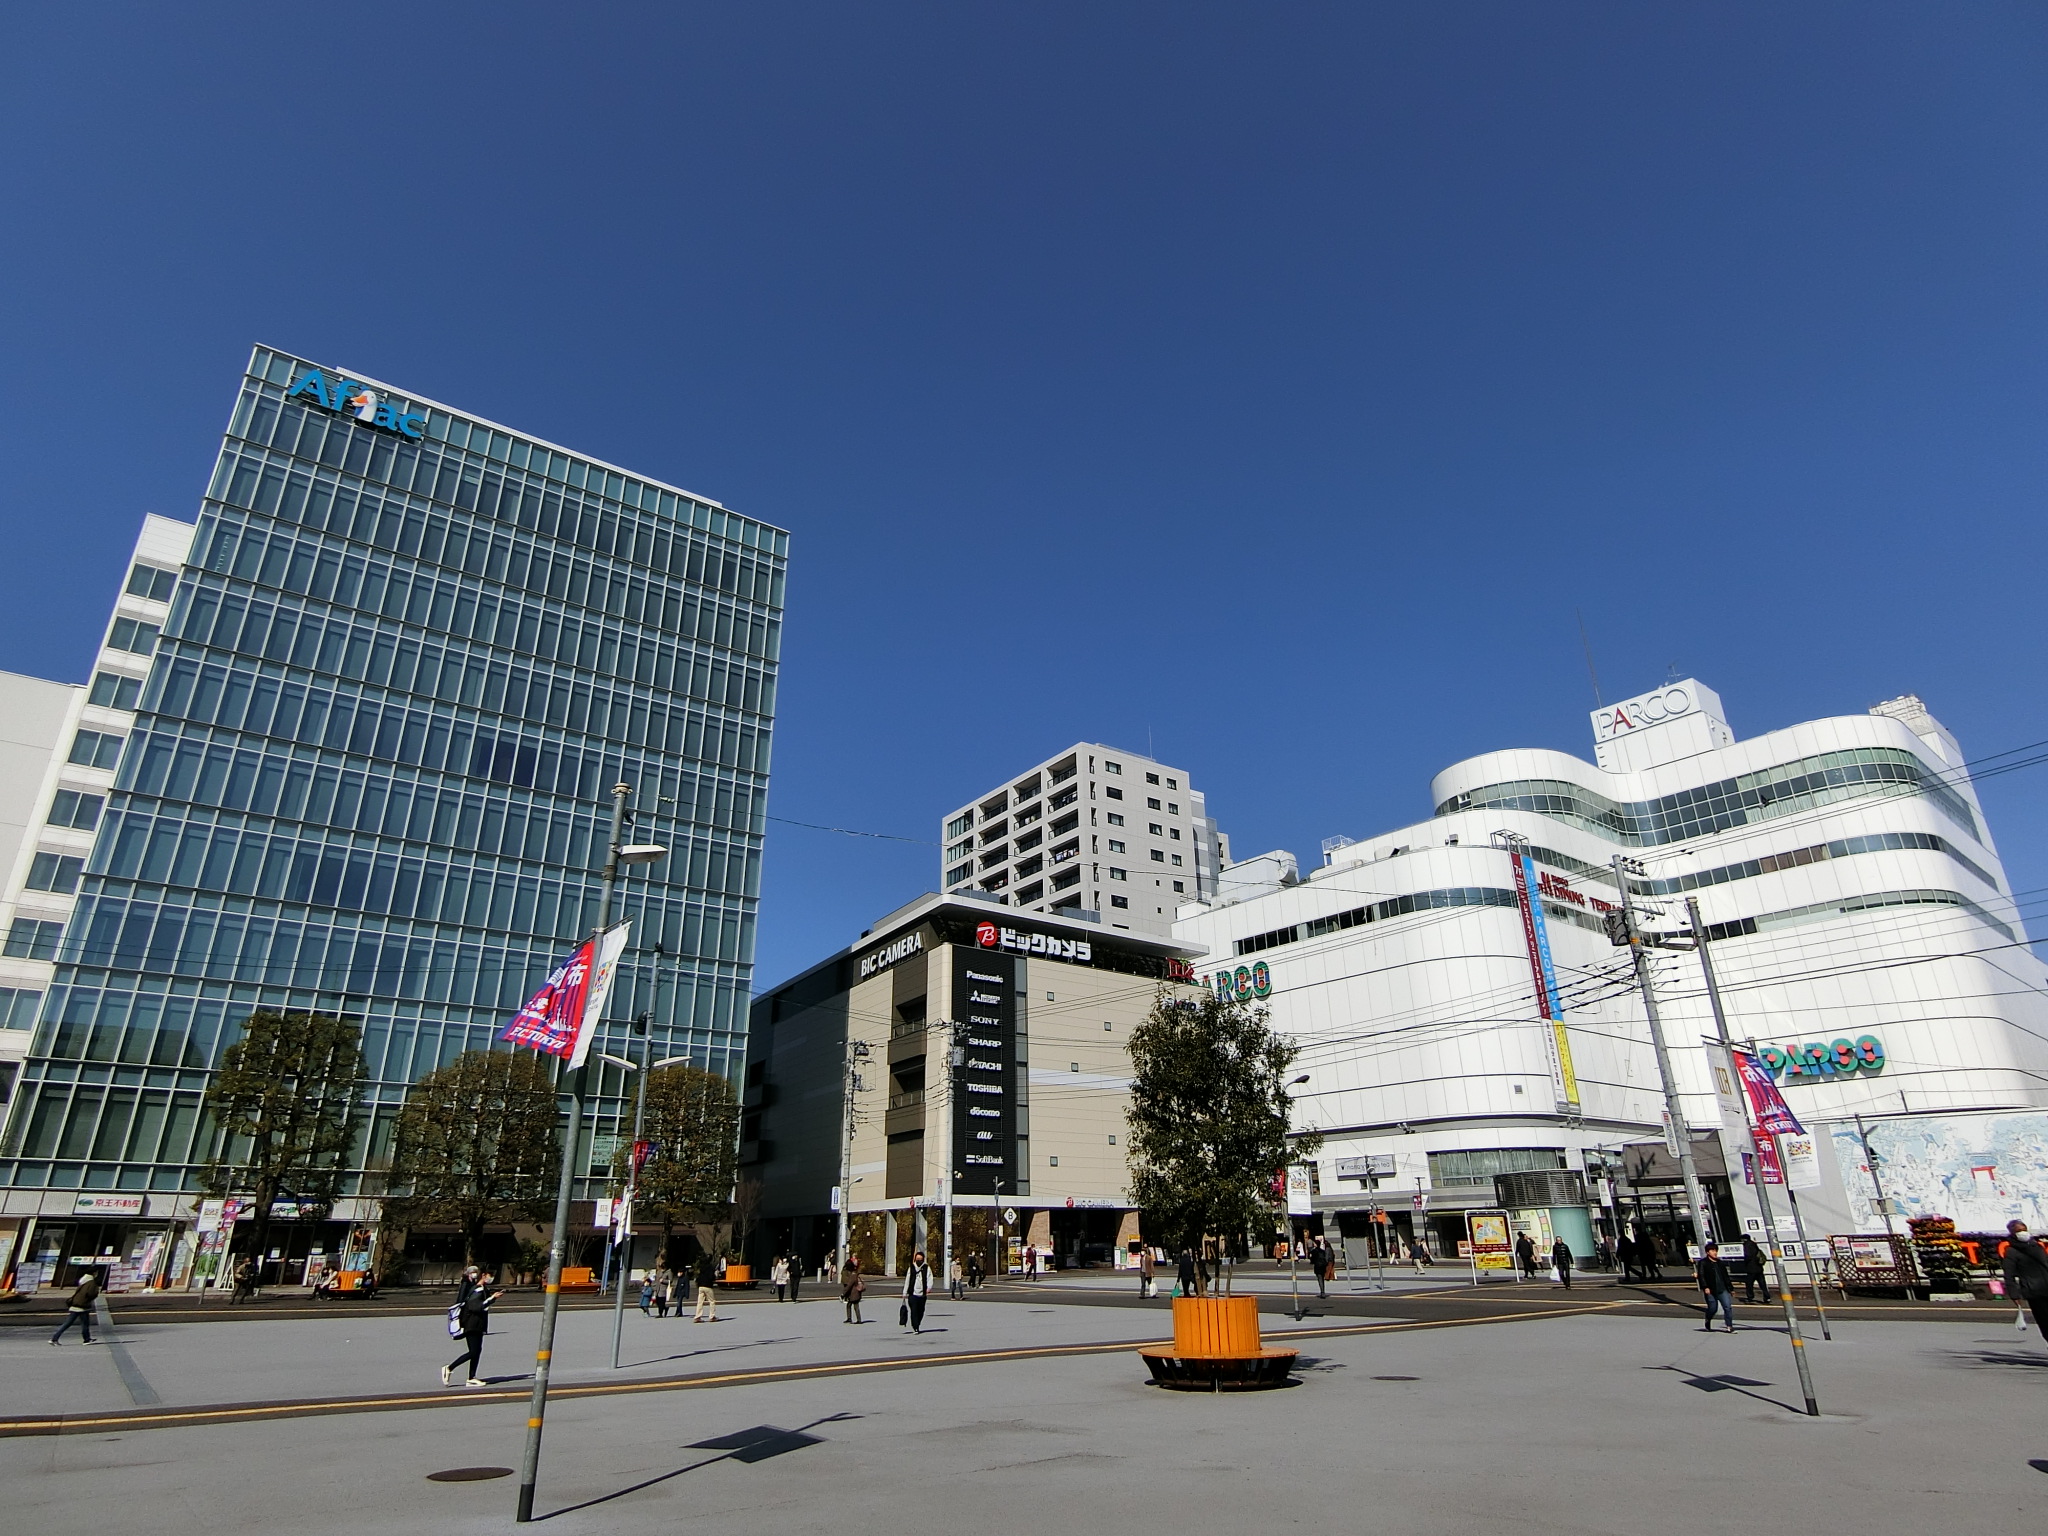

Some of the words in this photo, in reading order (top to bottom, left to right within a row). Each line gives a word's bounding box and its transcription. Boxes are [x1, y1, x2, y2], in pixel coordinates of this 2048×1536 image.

[1597, 687, 1691, 738] PARCO
[1553, 884, 1586, 907] DINING
[1000, 927, 1092, 961] ビックカメラ
[861, 954, 877, 977] BIC
[877, 931, 923, 968] CAMERA
[966, 970, 1004, 983] Panasonic
[971, 1015, 1000, 1025] SONY
[968, 1037, 1002, 1048] SHARP
[1759, 1034, 1885, 1081] PARCO
[967, 1083, 1003, 1094] TOSHIBA
[970, 1106, 1000, 1117] docomo
[976, 1131, 993, 1140] au
[975, 1154, 1003, 1165] SoftBank
[94, 1198, 141, 1208] 京王不動産
